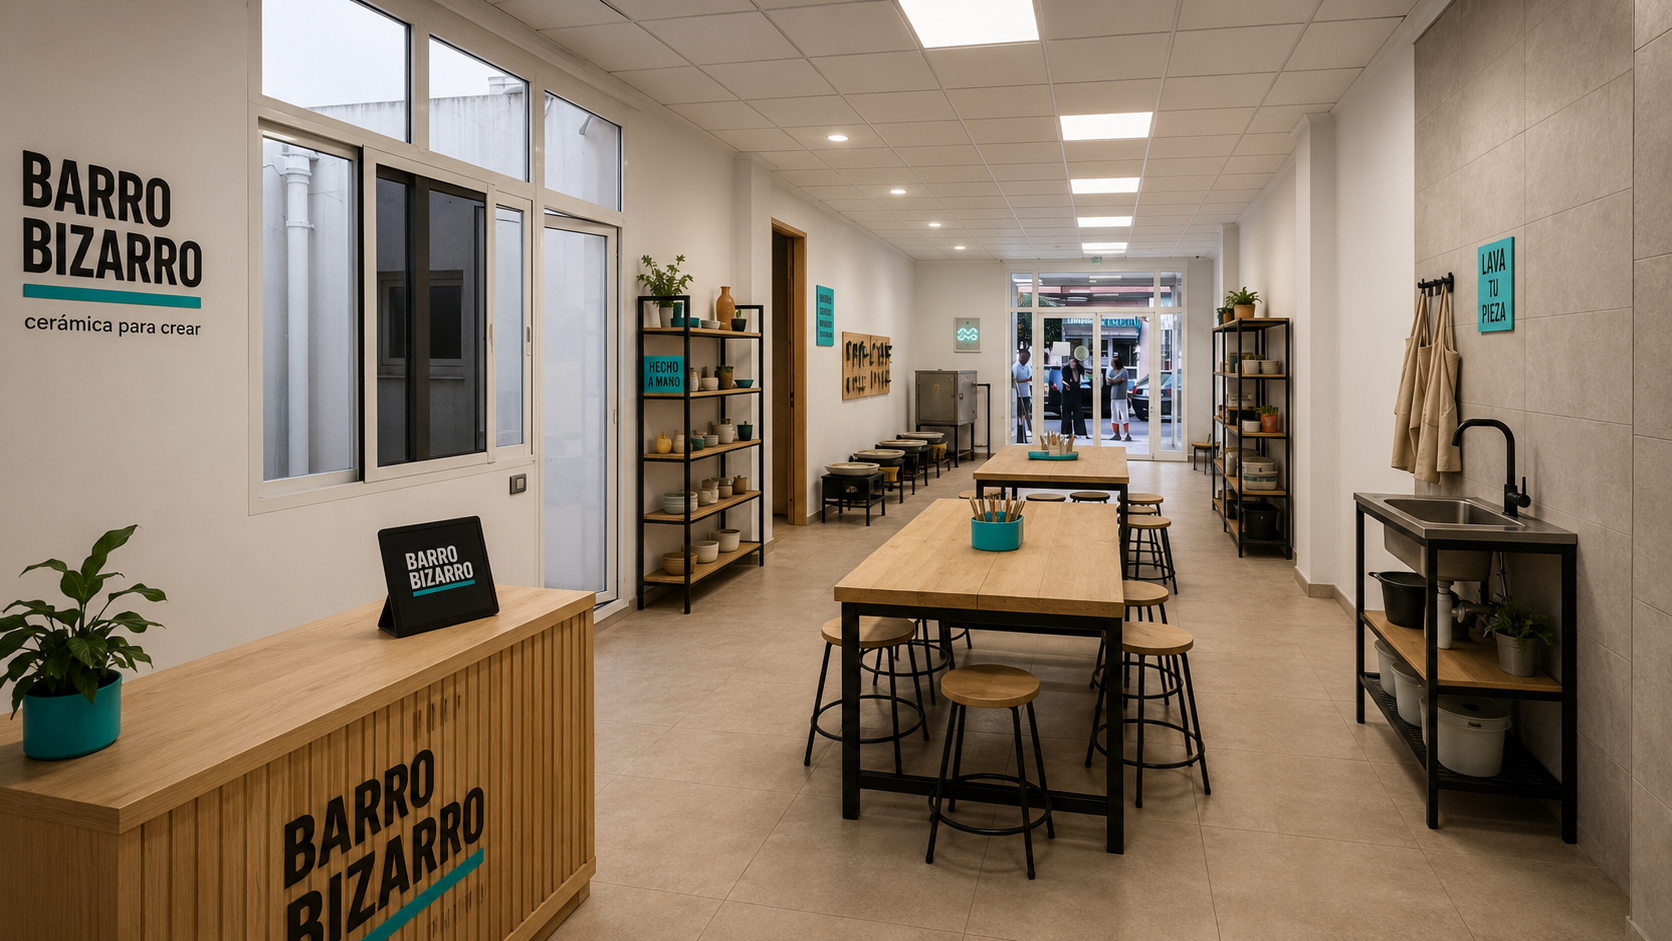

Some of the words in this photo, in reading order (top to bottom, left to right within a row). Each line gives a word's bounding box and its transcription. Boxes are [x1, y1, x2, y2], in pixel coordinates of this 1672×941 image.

[23, 149, 171, 228] BARRO
[23, 217, 202, 288] BIZARRO
[1482, 247, 1506, 275] LAVA
[1488, 278, 1499, 298] TU
[24, 313, 113, 332] cerámica
[119, 320, 156, 337] para
[160, 322, 201, 336] crear
[1482, 301, 1506, 324] PIEZA
[649, 361, 679, 373] HECHO
[648, 376, 654, 387] A
[655, 376, 680, 387] MANO
[405, 545, 458, 571] BARRO
[409, 561, 474, 590] BIZARRO
[284, 749, 435, 890] BARRO
[287, 786, 484, 941] BIZARRO
